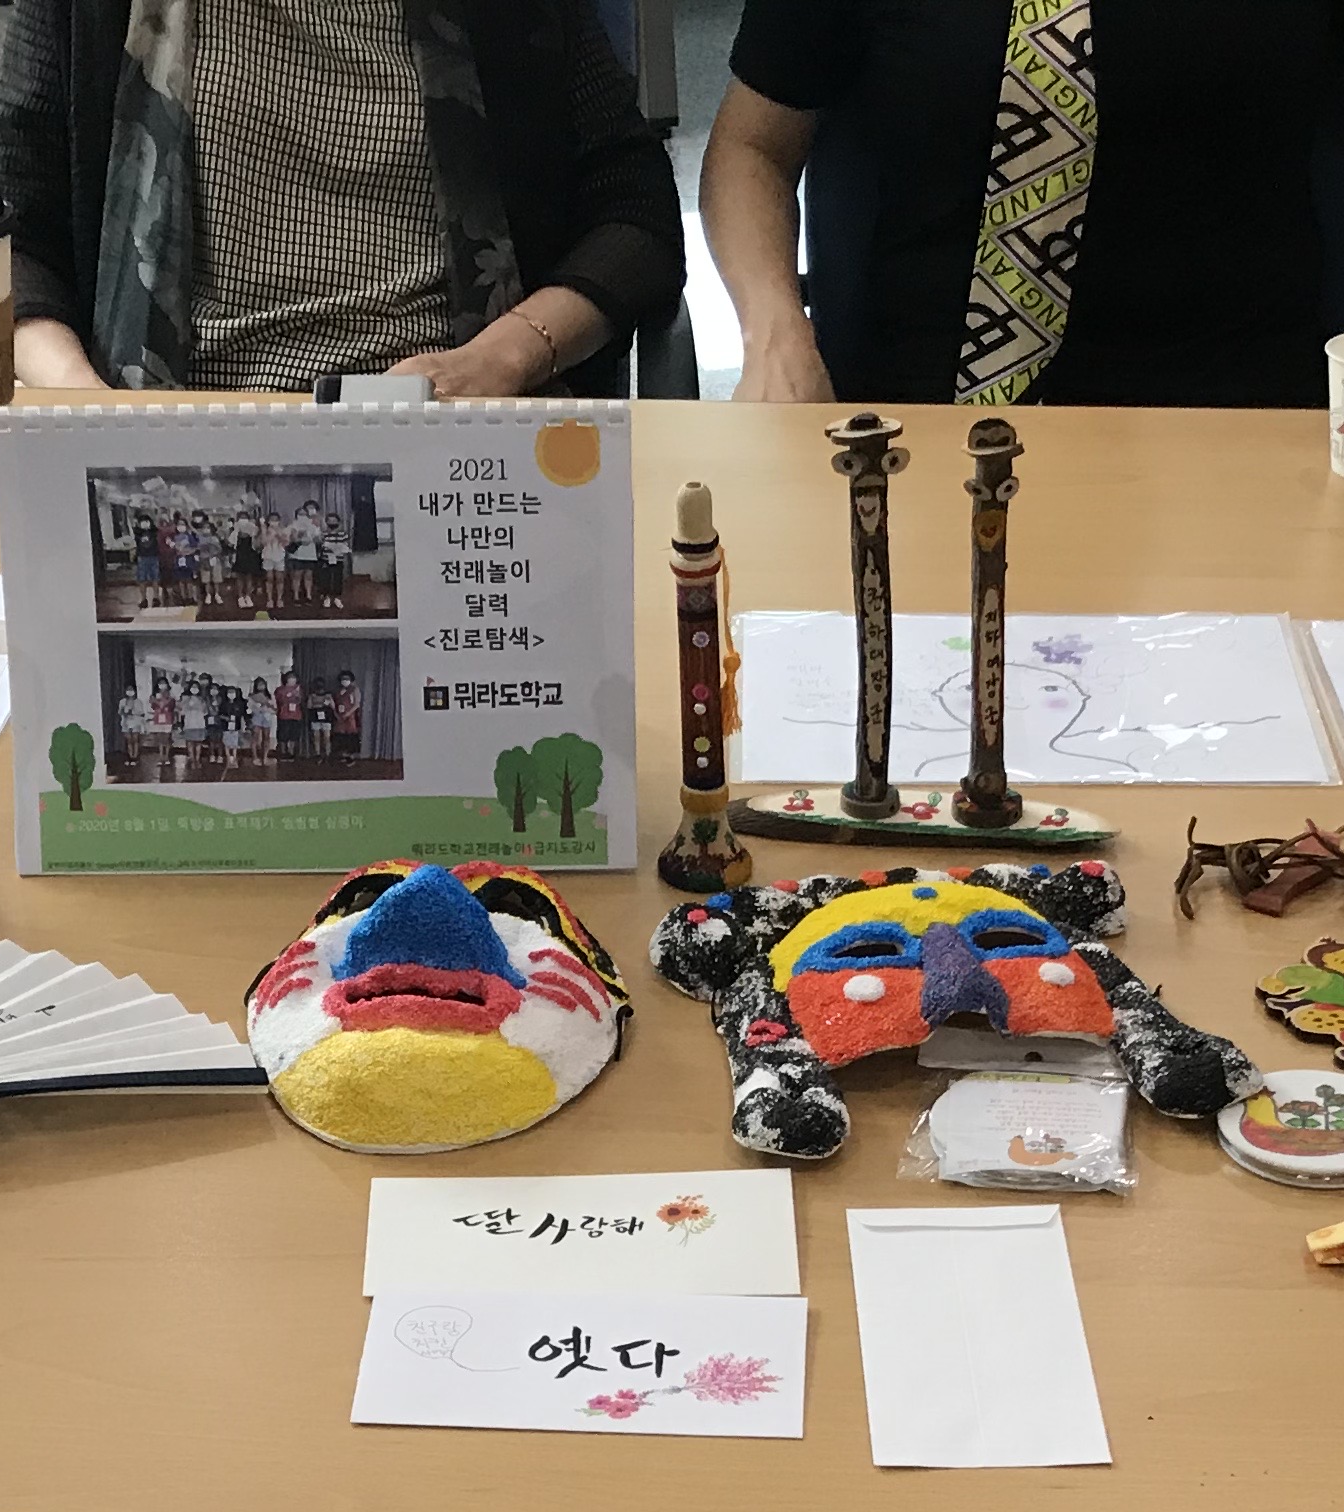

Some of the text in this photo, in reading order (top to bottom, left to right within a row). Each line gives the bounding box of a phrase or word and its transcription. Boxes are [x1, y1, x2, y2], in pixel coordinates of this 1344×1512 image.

[449, 458, 508, 482] 2021
[419, 491, 542, 516] 내가 만드는
[447, 525, 514, 550] 나만의
[440, 559, 531, 585] 전래놀이
[465, 593, 508, 618] 달력
[424, 625, 545, 652] <진로탐색>
[453, 680, 564, 710] 뭐라도학교
[528, 1212, 645, 1246] 사랑해
